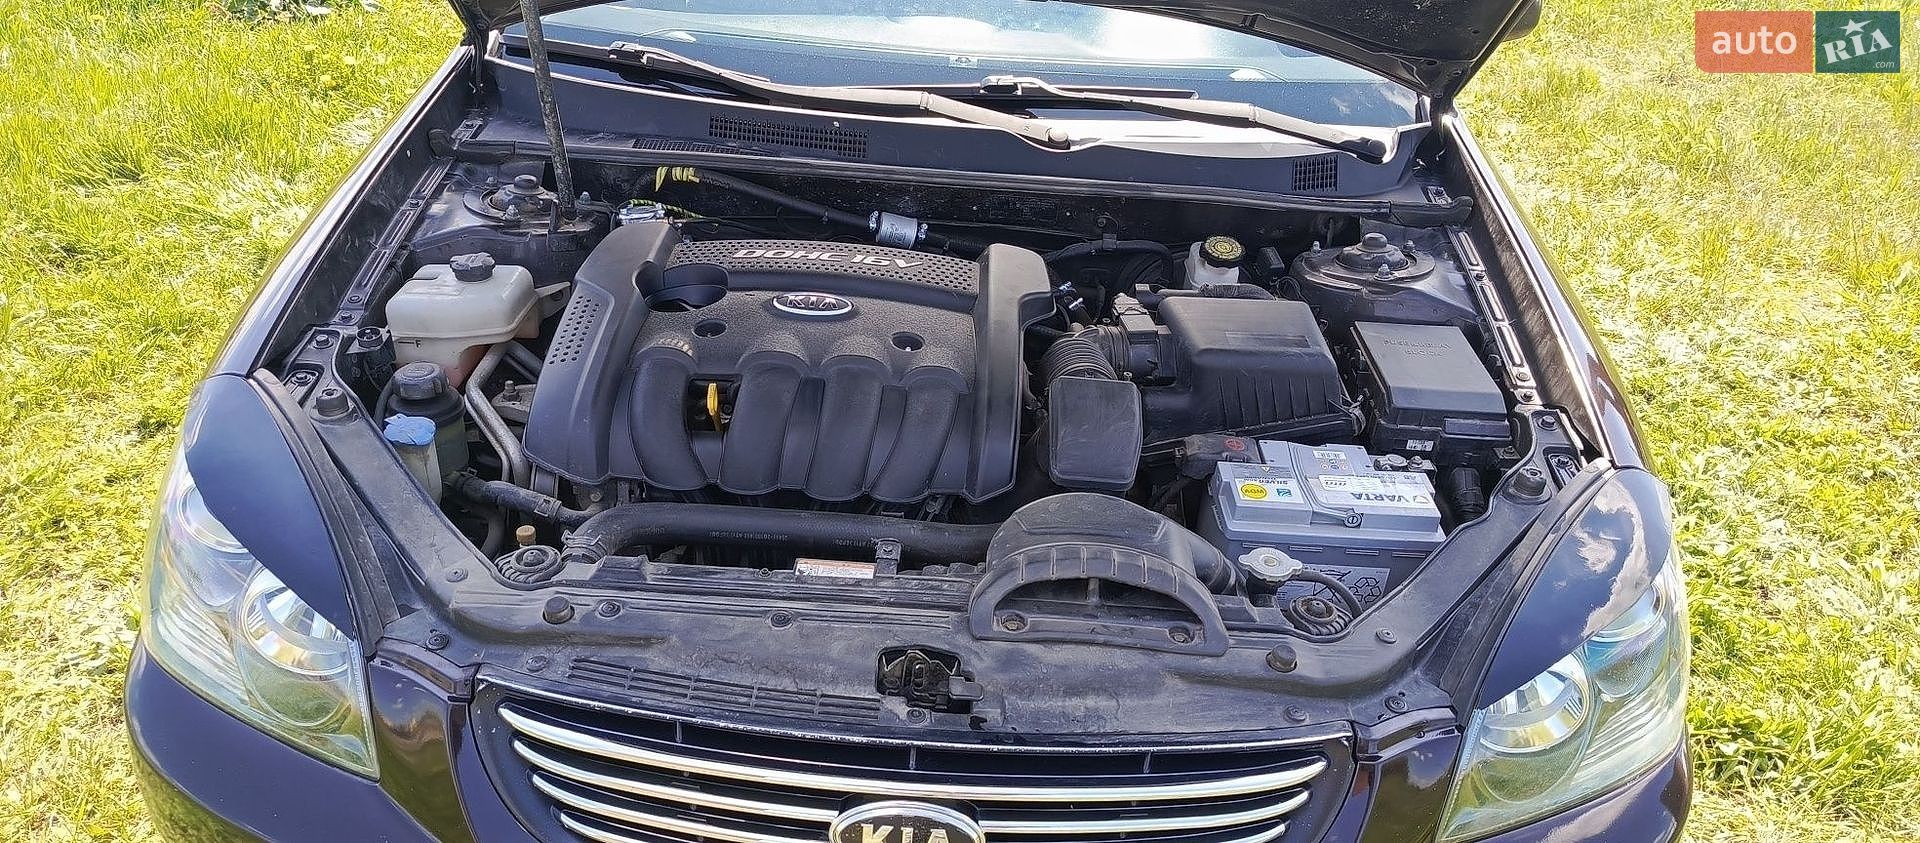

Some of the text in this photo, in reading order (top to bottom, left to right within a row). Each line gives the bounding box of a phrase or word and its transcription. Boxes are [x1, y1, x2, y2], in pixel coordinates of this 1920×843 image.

[732, 249, 923, 269] DOHC 16V
[786, 295, 838, 310] KIA
[1350, 492, 1410, 503] VARTA
[861, 823, 950, 843] KIA
